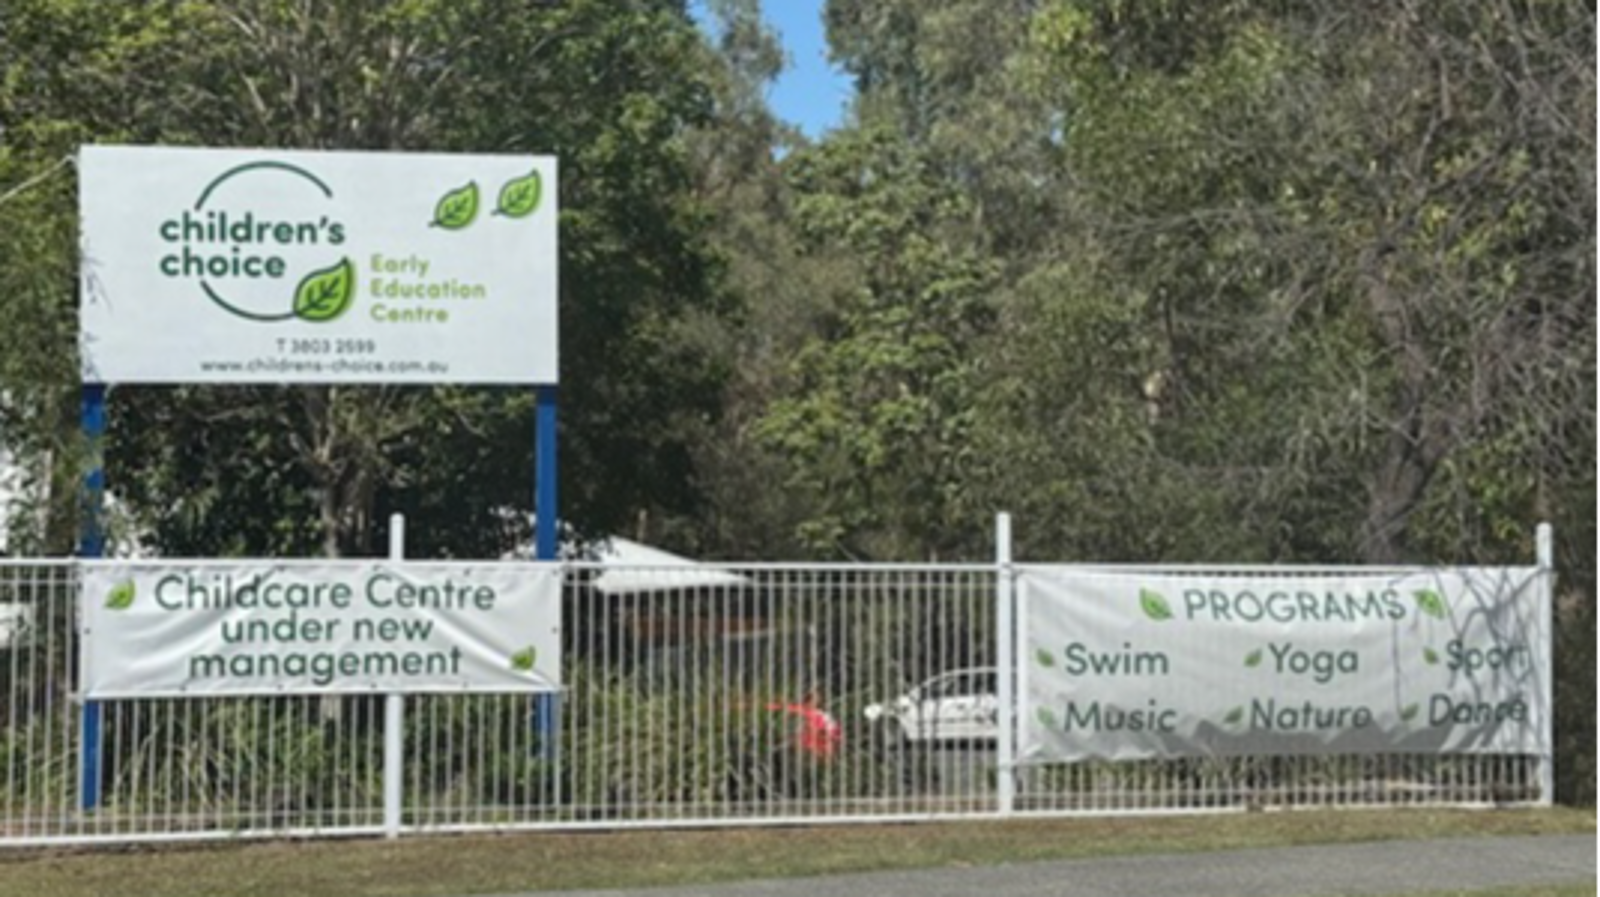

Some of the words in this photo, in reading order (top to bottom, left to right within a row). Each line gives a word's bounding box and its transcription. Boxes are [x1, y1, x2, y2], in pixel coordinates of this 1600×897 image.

[160, 211, 346, 245] children's
[160, 245, 286, 279] choice
[370, 254, 430, 277] Early
[370, 279, 486, 301] Education
[370, 303, 449, 324] Centre
[276, 339, 286, 353] T
[291, 339, 331, 354] 3803
[200, 357, 449, 373] www.childrens-choice.com.au
[154, 574, 353, 611] Childcare
[365, 573, 496, 611] Centre
[1184, 588, 1406, 623] PROGRAMS
[221, 612, 341, 643] under
[352, 616, 433, 641] new
[189, 645, 462, 685] management
[1065, 642, 1169, 676] Swim
[1268, 643, 1359, 683] Yoga
[1064, 699, 1177, 733] Music
[1251, 699, 1372, 731] Nature
